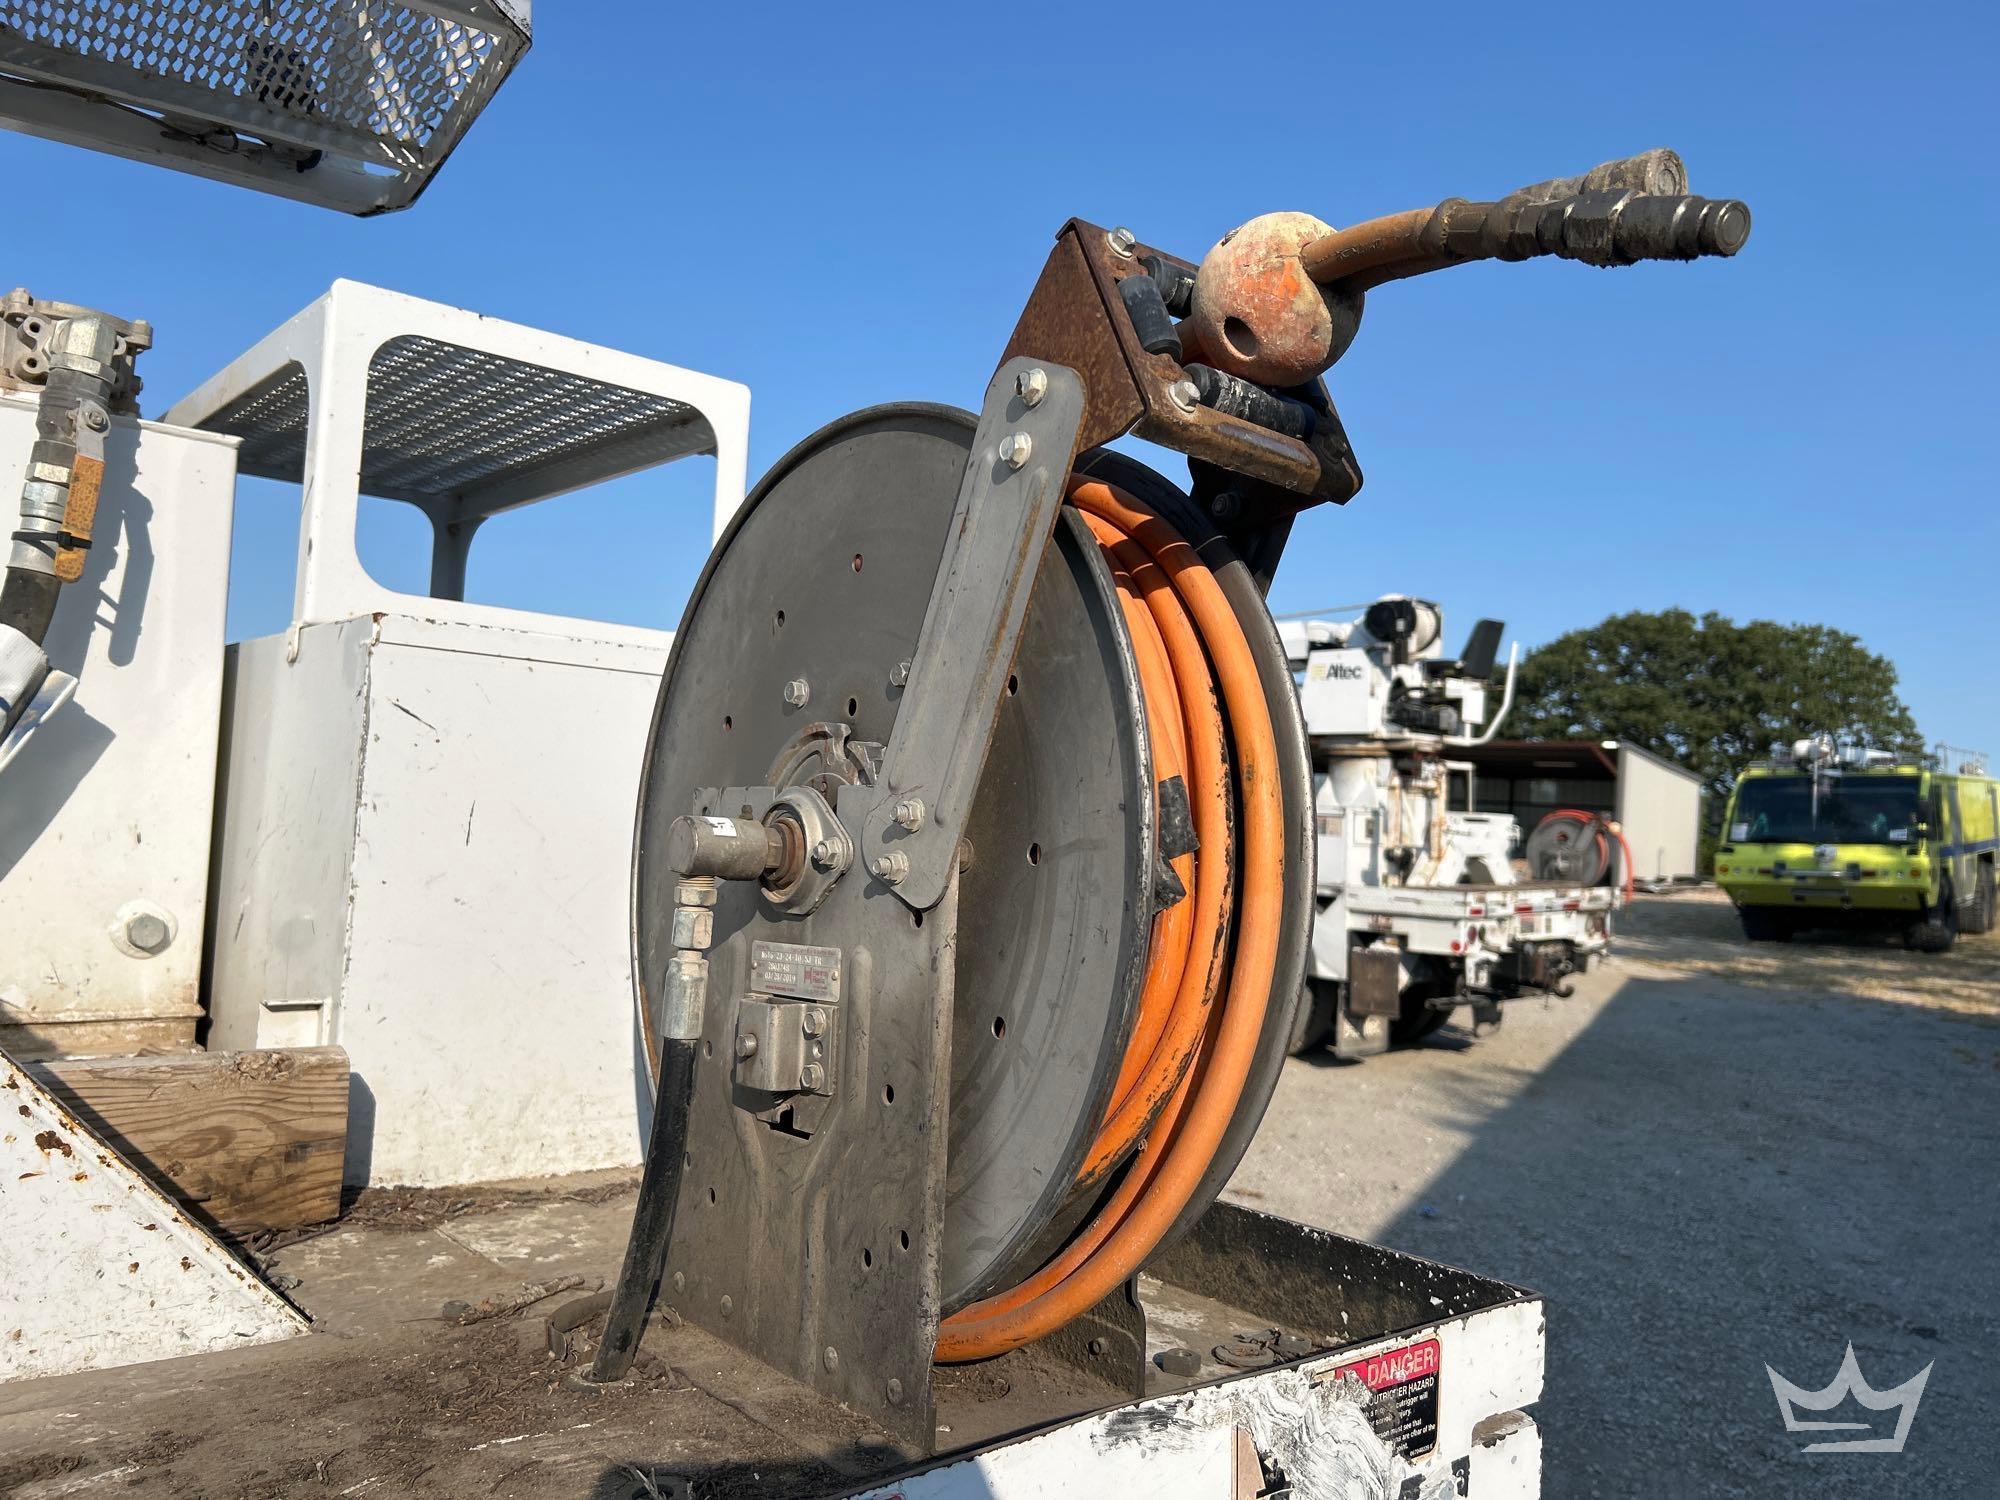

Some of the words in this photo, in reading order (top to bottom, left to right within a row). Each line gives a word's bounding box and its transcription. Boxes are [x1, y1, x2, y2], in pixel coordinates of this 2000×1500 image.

[1326, 662, 1362, 680] Altec
[1367, 1346, 1435, 1387] DANGER
[1408, 1376, 1435, 1395] HAZARD
